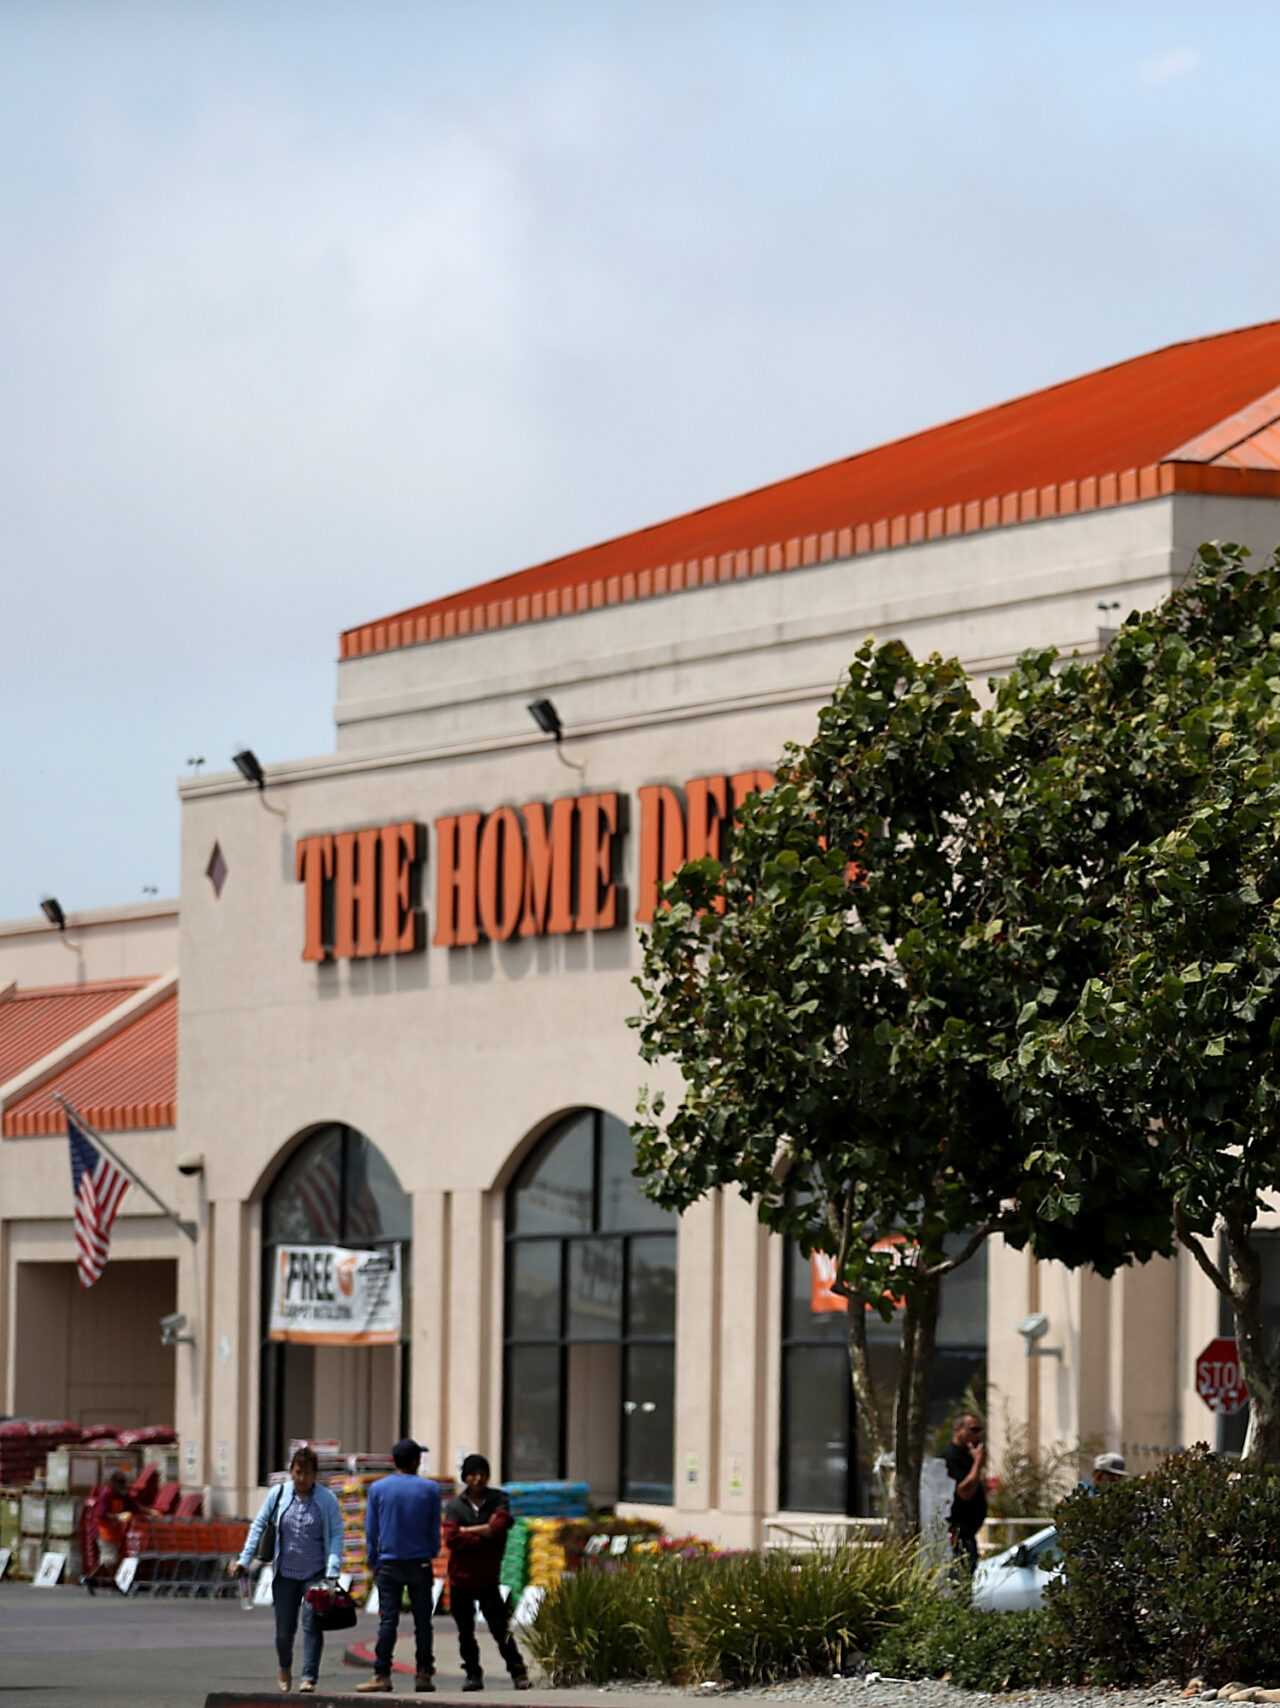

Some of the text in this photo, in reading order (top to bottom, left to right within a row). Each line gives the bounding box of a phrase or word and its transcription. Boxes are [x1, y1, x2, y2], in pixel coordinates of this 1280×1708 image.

[296, 822, 416, 962] THE
[433, 792, 618, 947] HOME
[1199, 1362, 1243, 1388] STO
